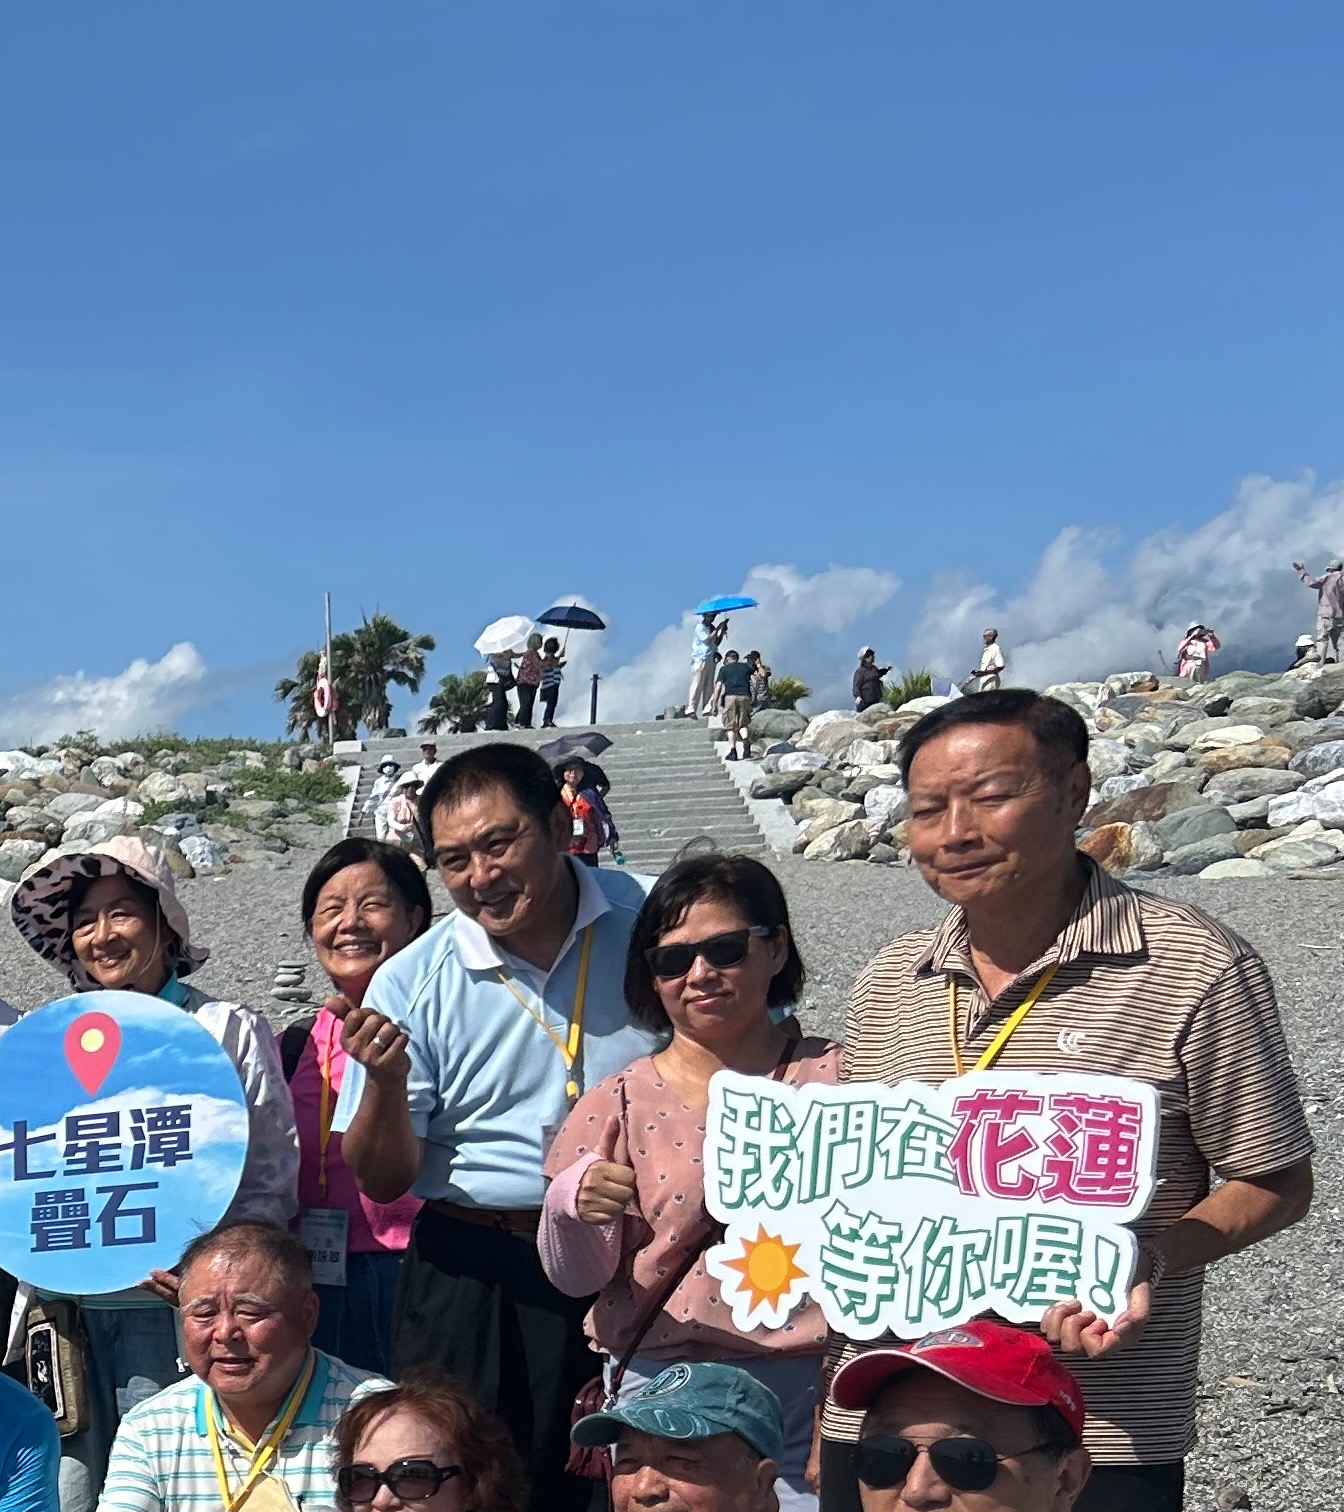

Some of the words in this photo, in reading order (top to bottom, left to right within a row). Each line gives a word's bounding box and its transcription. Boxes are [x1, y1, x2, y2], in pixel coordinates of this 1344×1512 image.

[718, 1088, 1143, 1210] 我們在花蓮
[30, 1181, 159, 1253] 疊石
